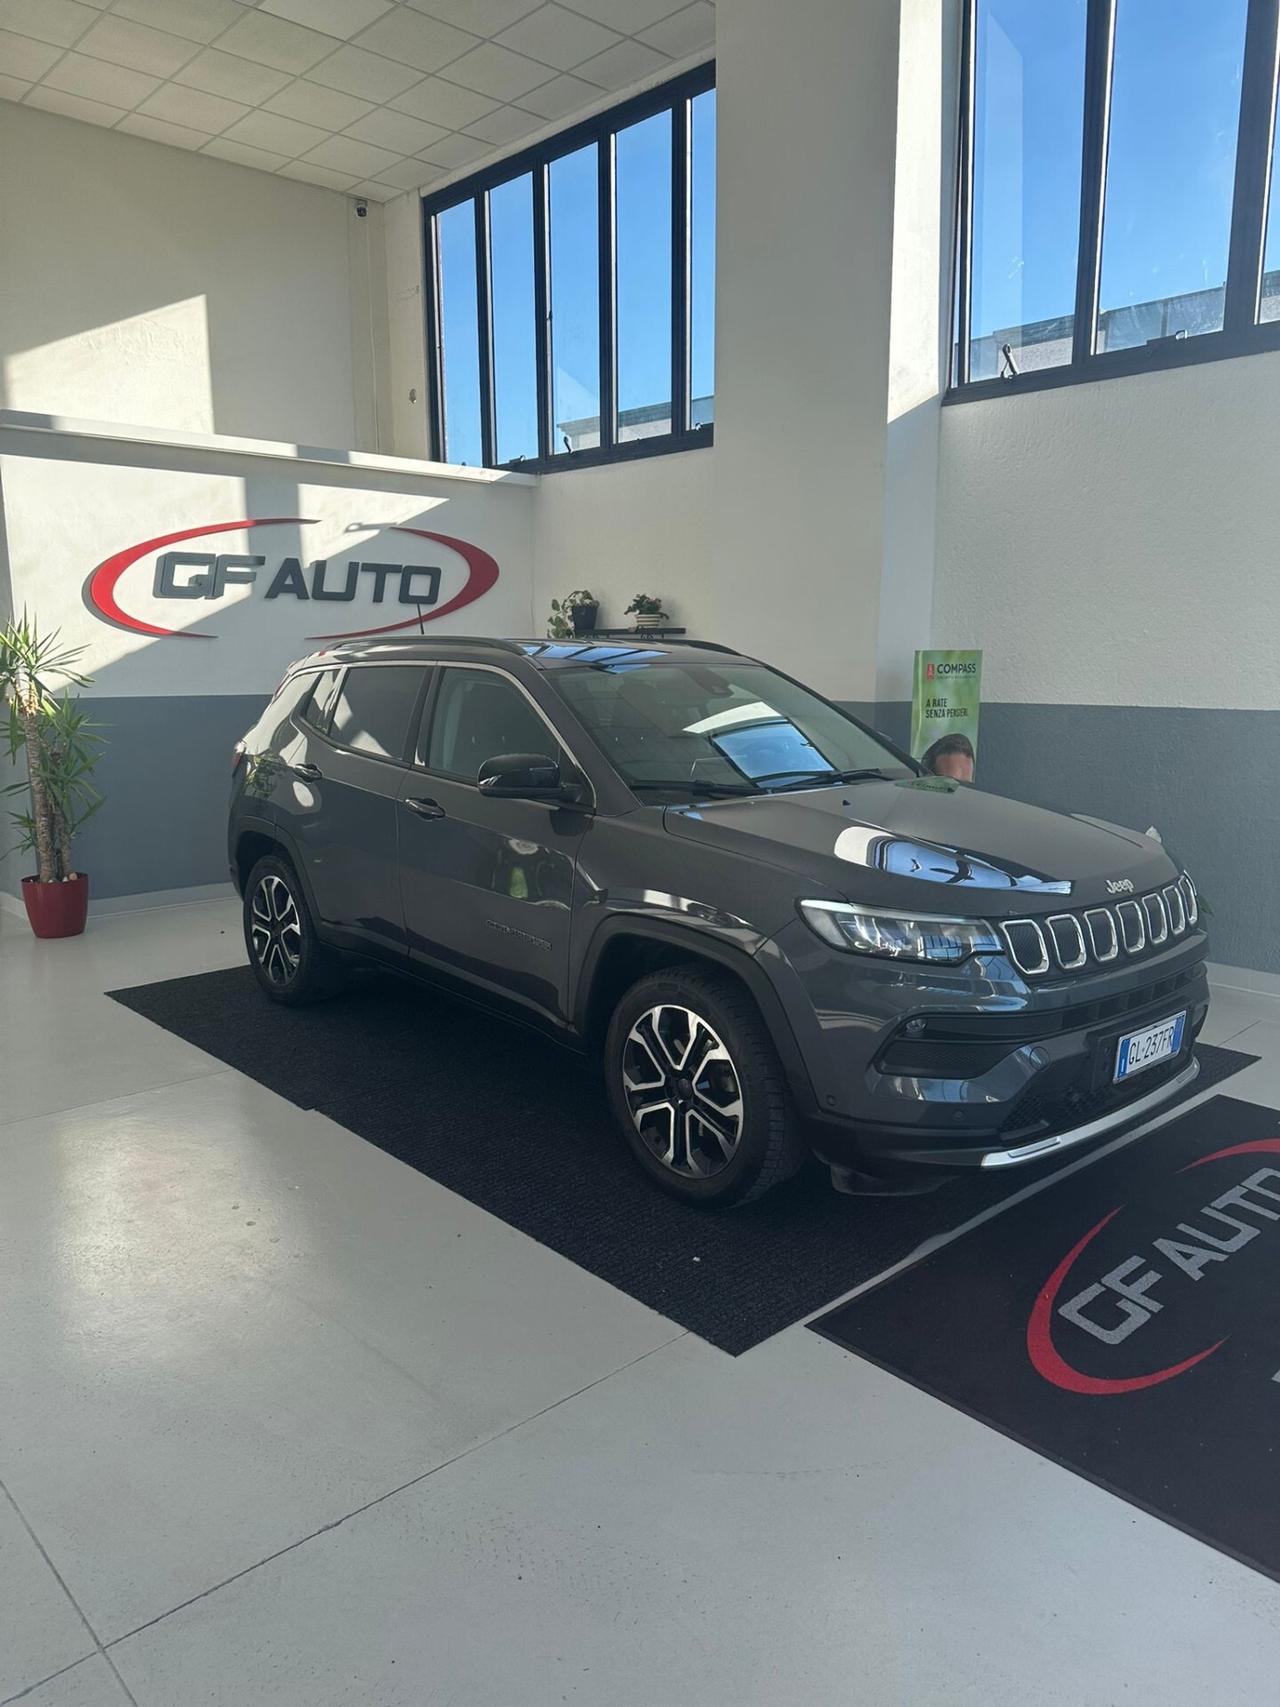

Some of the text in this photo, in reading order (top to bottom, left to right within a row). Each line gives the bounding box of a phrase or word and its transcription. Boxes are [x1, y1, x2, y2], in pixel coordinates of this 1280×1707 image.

[153, 551, 442, 605] GF AUTO
[937, 663, 976, 674] COMPASS
[926, 698, 947, 708] A RATE
[925, 708, 945, 719] SENZA
[1105, 879, 1134, 894] Jeep
[1057, 1255, 1164, 1345] GF
